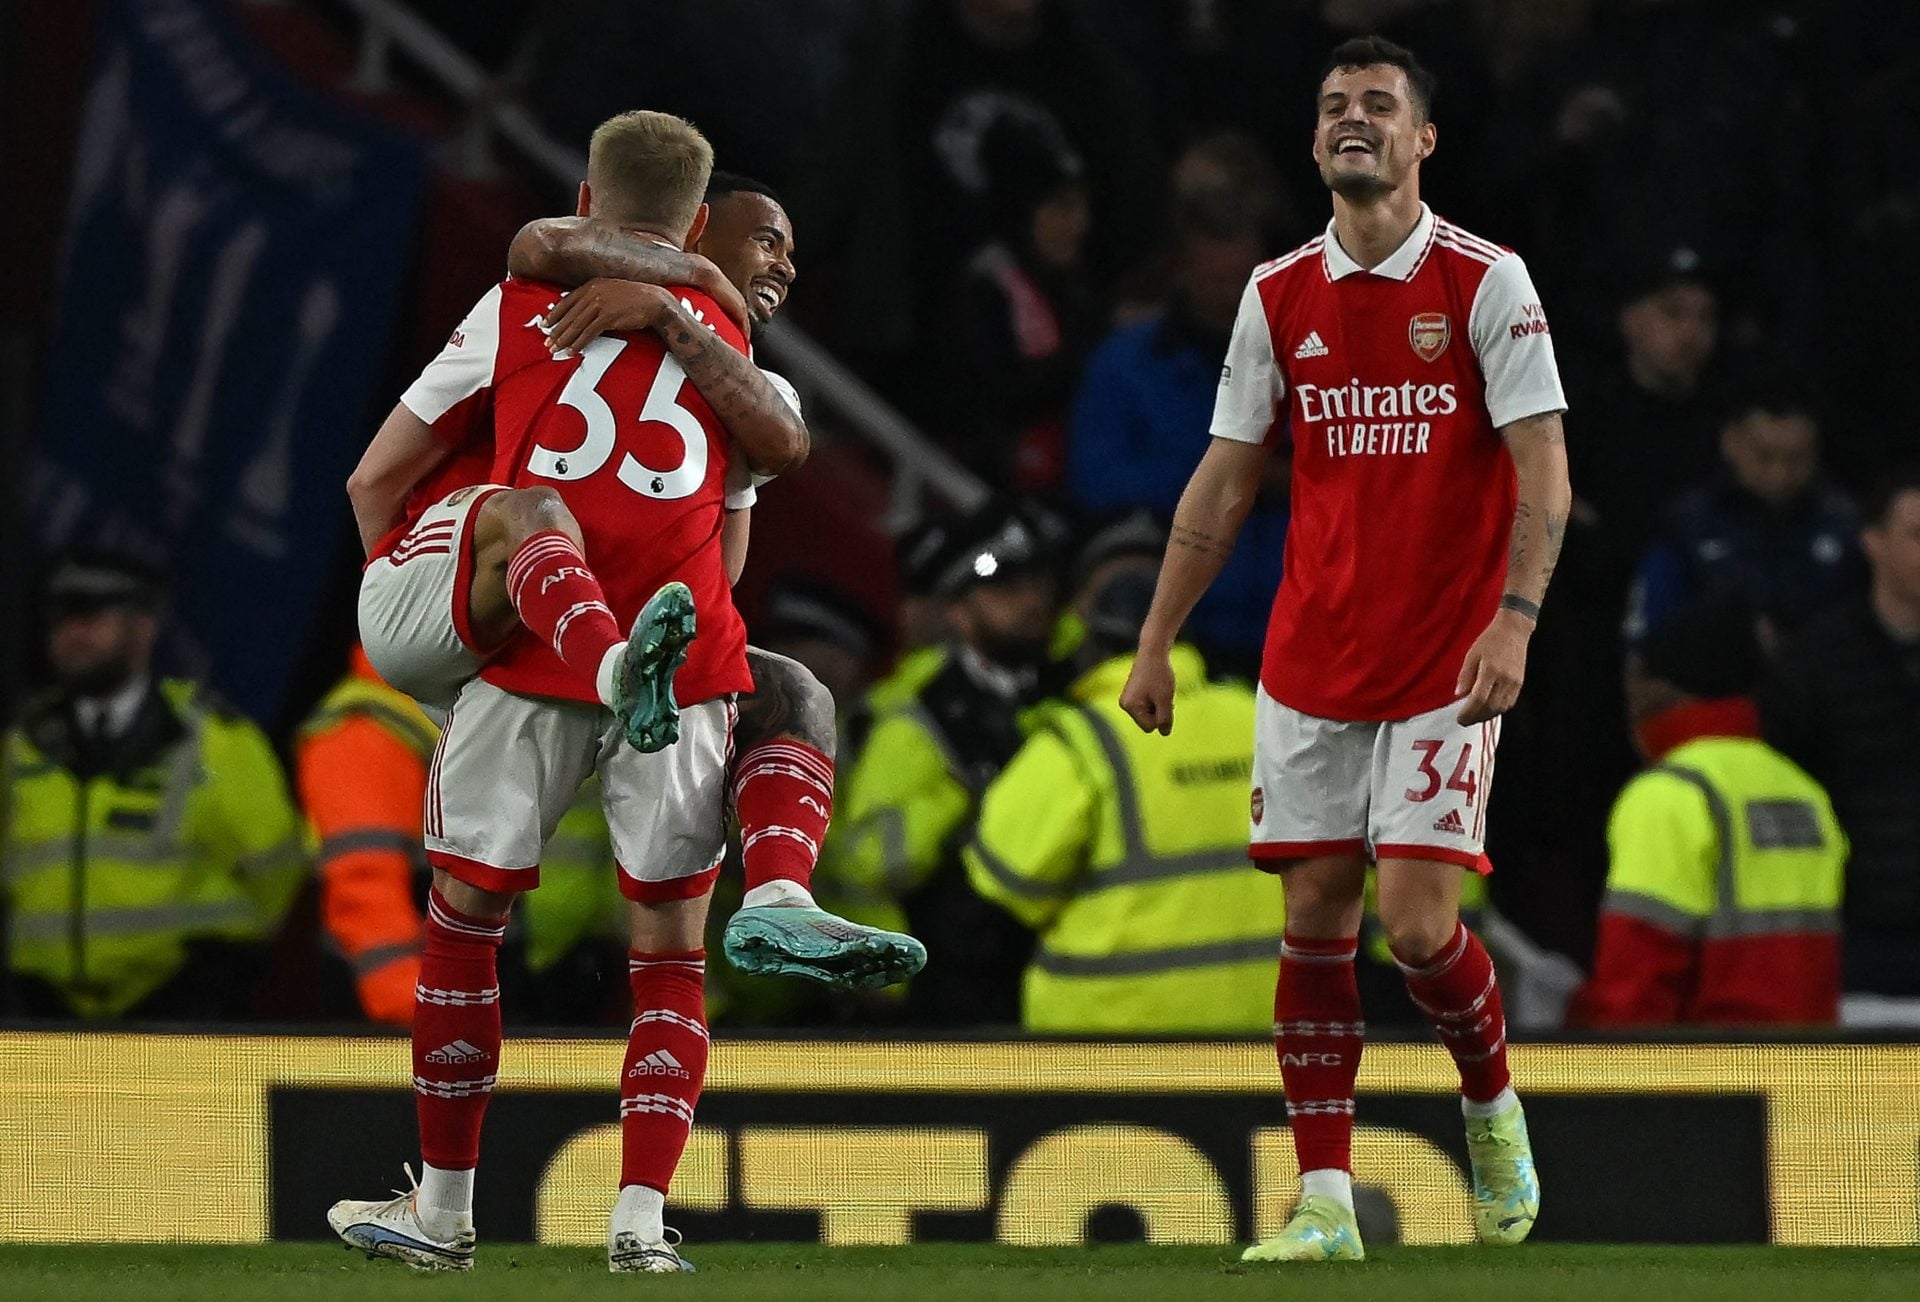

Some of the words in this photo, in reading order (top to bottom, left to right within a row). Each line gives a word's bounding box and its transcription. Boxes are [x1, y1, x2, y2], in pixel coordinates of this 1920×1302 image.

[1295, 346, 1329, 359] adidas
[1295, 378, 1457, 422] Emirates
[527, 336, 708, 500] 35
[1327, 424, 1349, 457] FL
[1350, 422, 1431, 455] BETTER
[541, 566, 595, 595] AFC
[1404, 741, 1476, 807] 34
[425, 1051, 491, 1064] adidas
[628, 1064, 690, 1080] adidas
[1281, 1053, 1342, 1067] AFC
